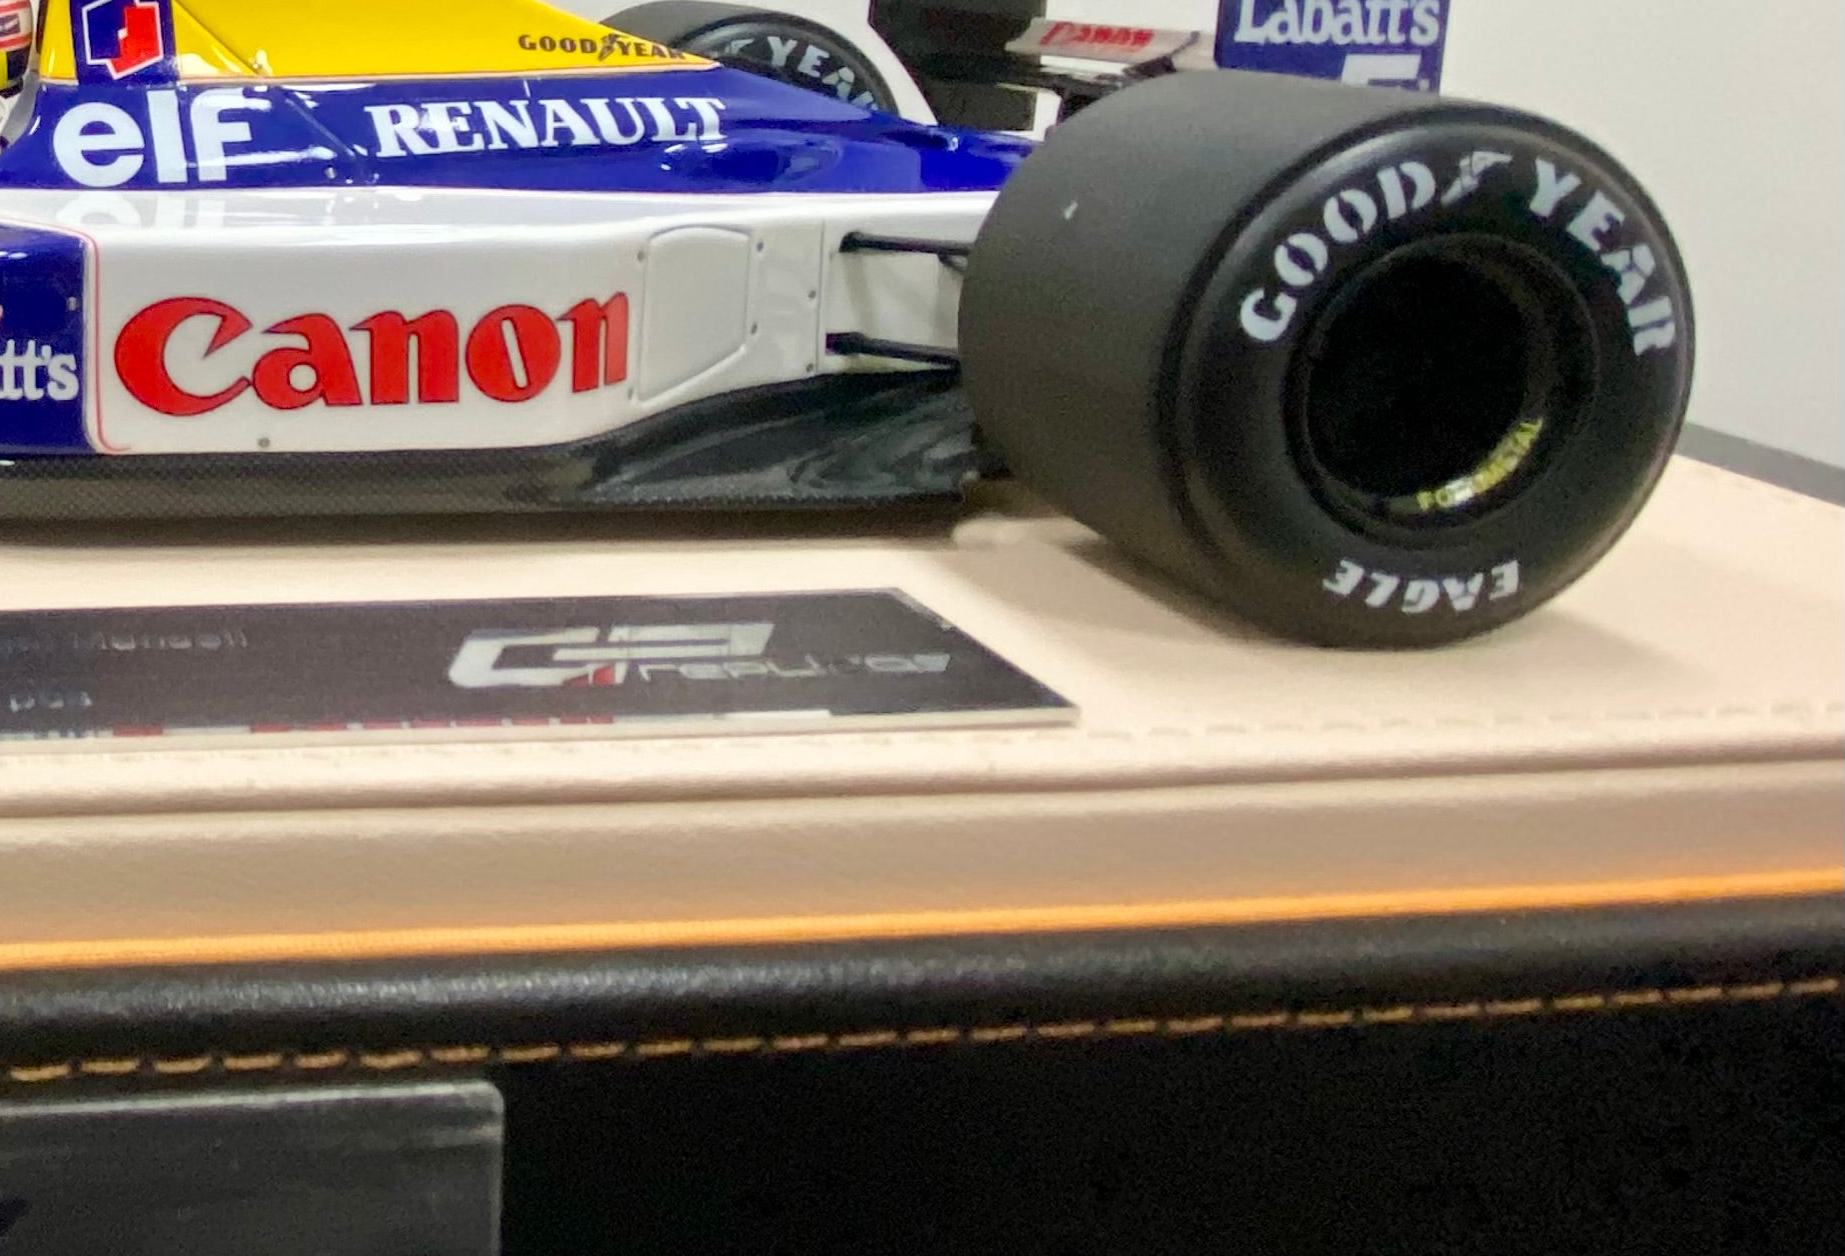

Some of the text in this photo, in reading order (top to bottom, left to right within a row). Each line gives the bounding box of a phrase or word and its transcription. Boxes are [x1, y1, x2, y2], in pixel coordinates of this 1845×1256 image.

[54, 88, 273, 188] elf
[364, 97, 727, 159] RENAULT
[114, 291, 630, 416] Canon
[1322, 559, 1520, 614] EAGLE
